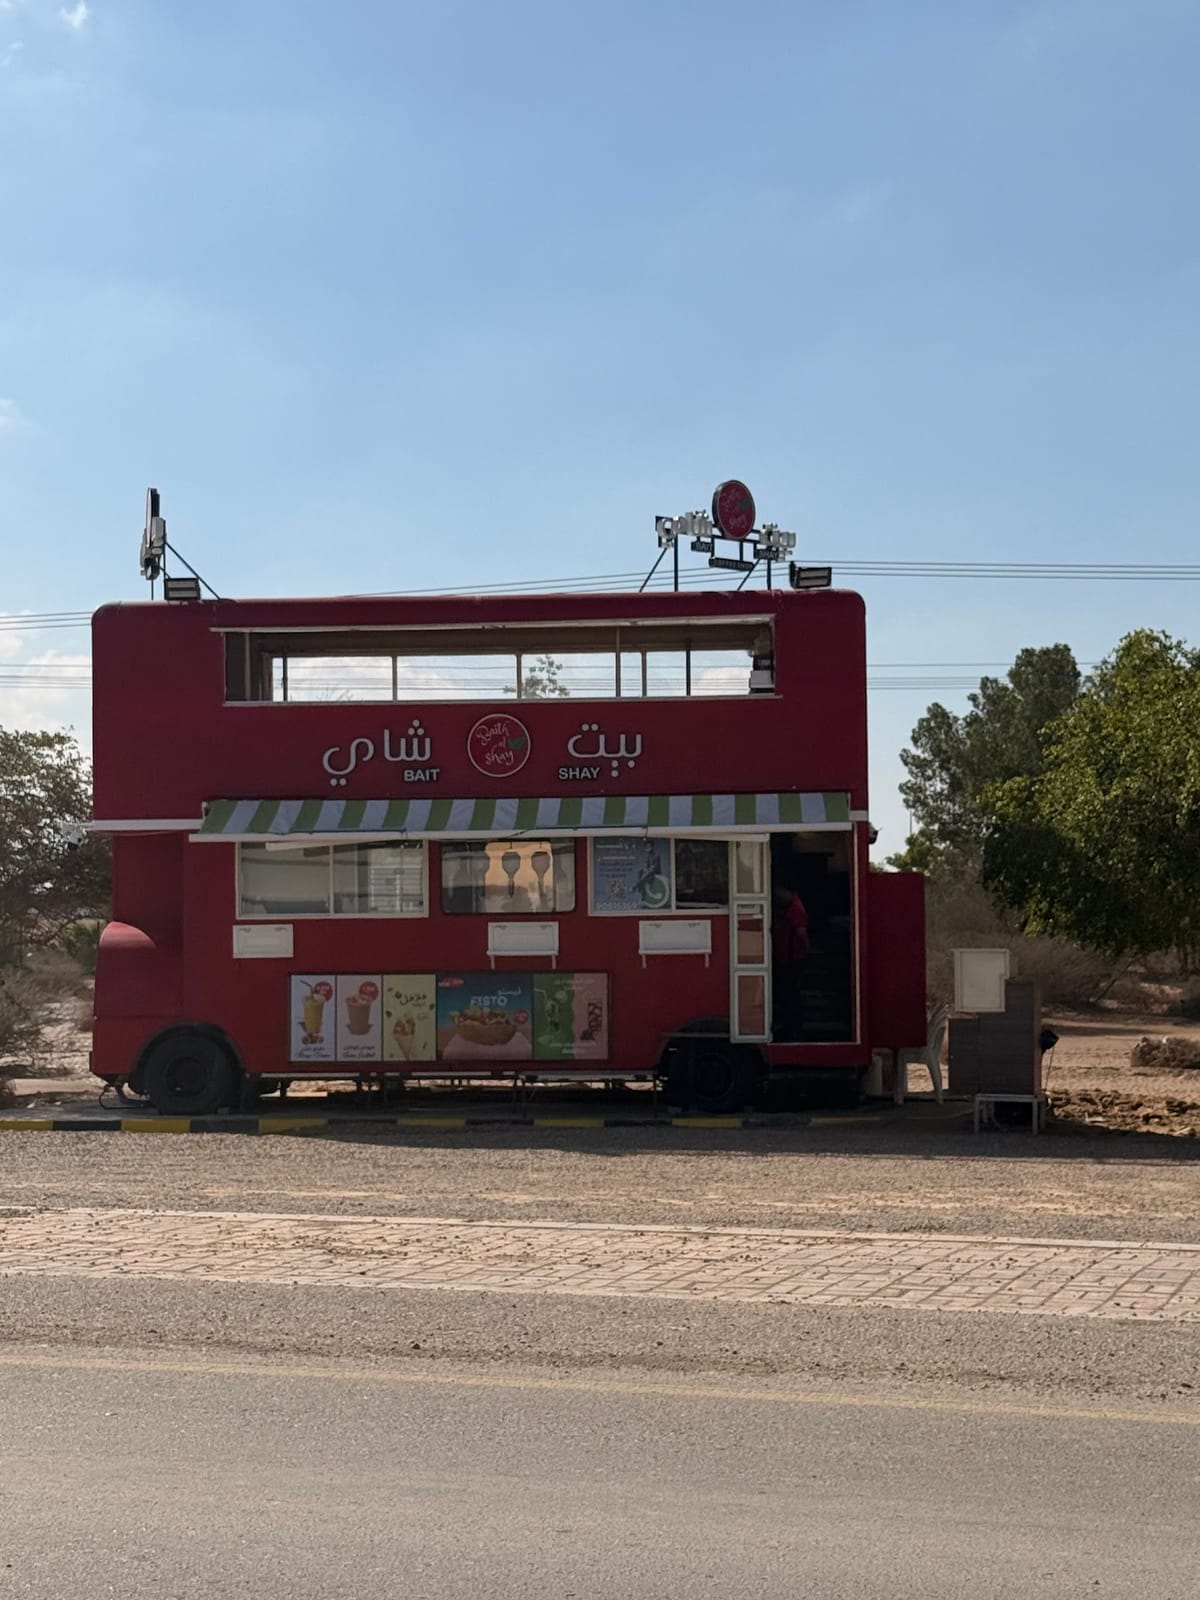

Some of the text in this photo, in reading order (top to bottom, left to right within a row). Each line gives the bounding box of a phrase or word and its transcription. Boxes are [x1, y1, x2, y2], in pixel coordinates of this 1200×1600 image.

[323, 719, 642, 786] بيت شاي
[404, 767, 600, 782] BAIT SHAY
